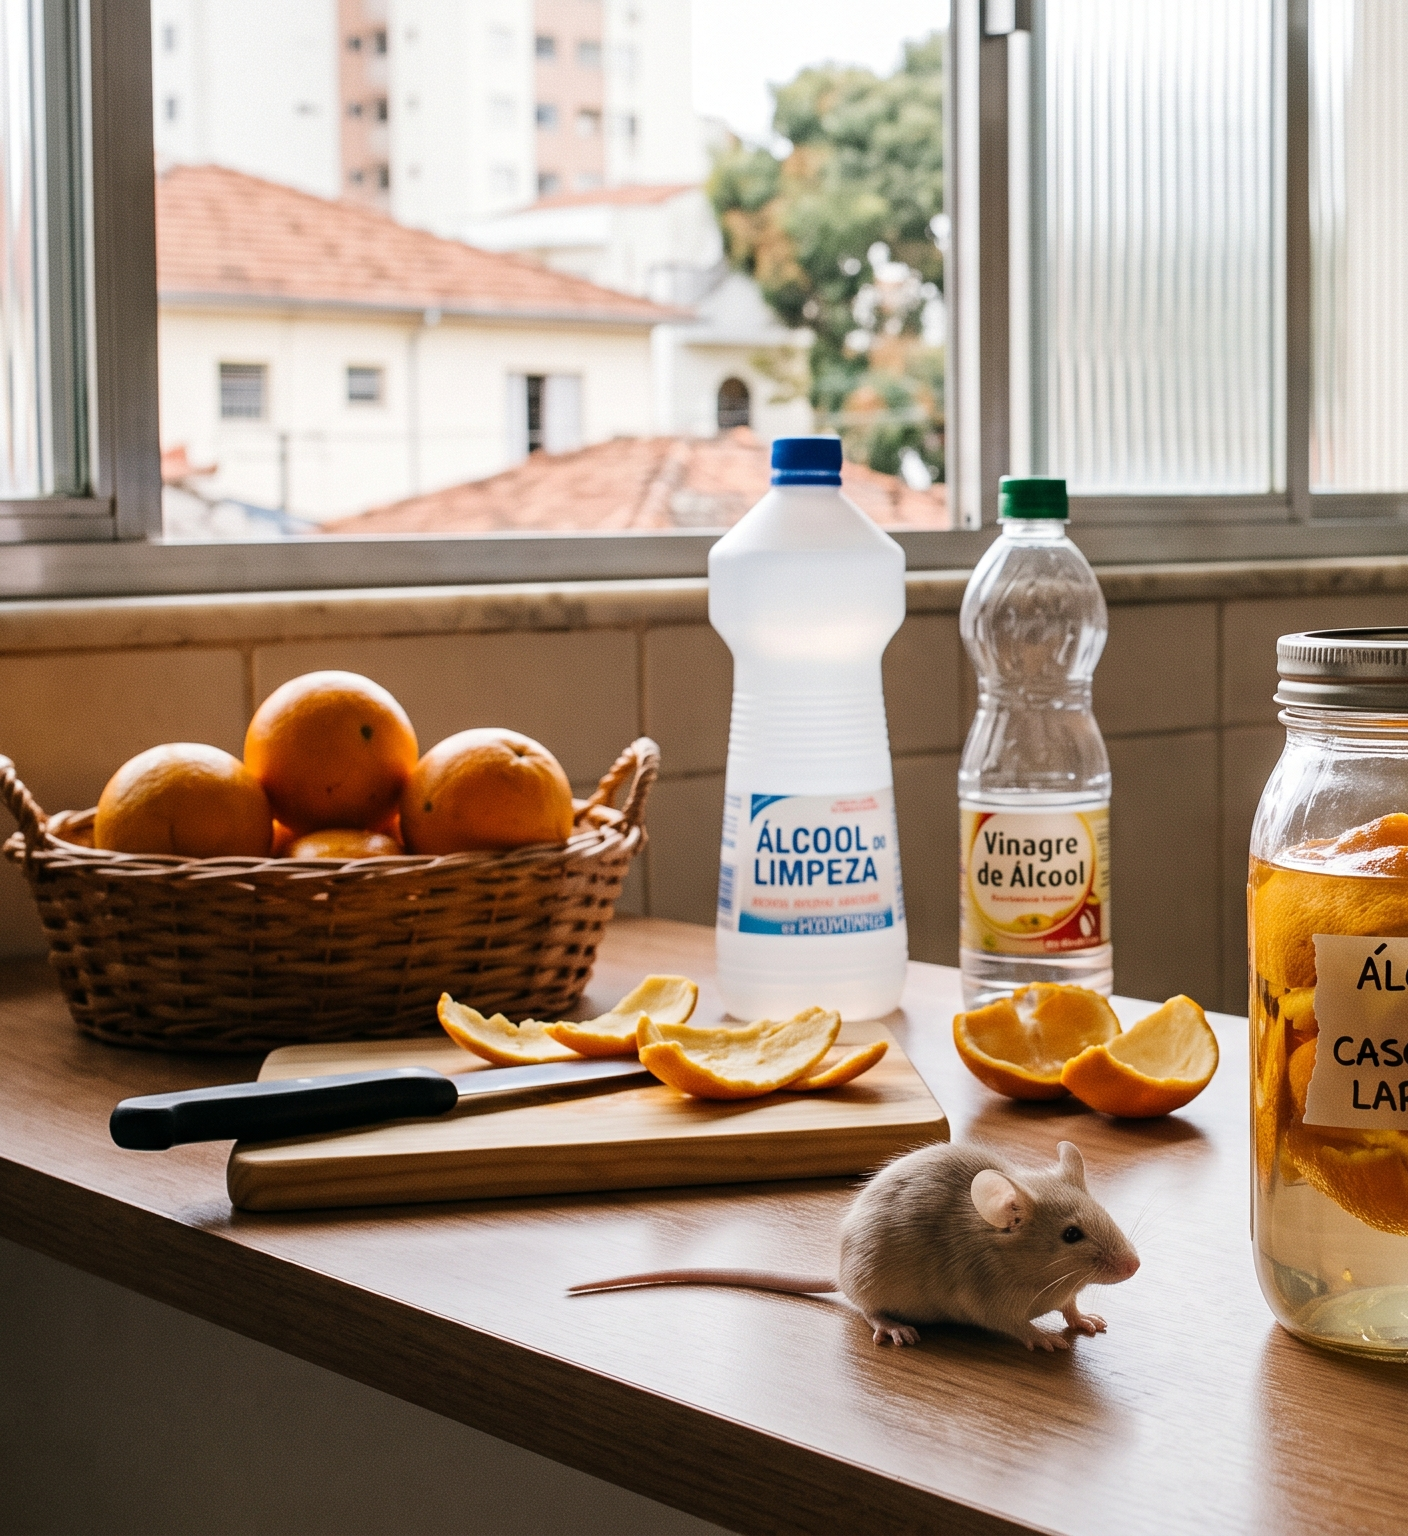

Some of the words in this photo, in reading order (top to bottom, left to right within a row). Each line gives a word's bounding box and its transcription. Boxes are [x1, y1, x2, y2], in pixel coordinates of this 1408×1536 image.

[756, 820, 868, 854] ÁLCOOL
[984, 831, 1078, 862] Vinagre
[755, 857, 878, 886] LIMPEZA
[977, 861, 1003, 887] de
[1010, 861, 1084, 887] Álcool
